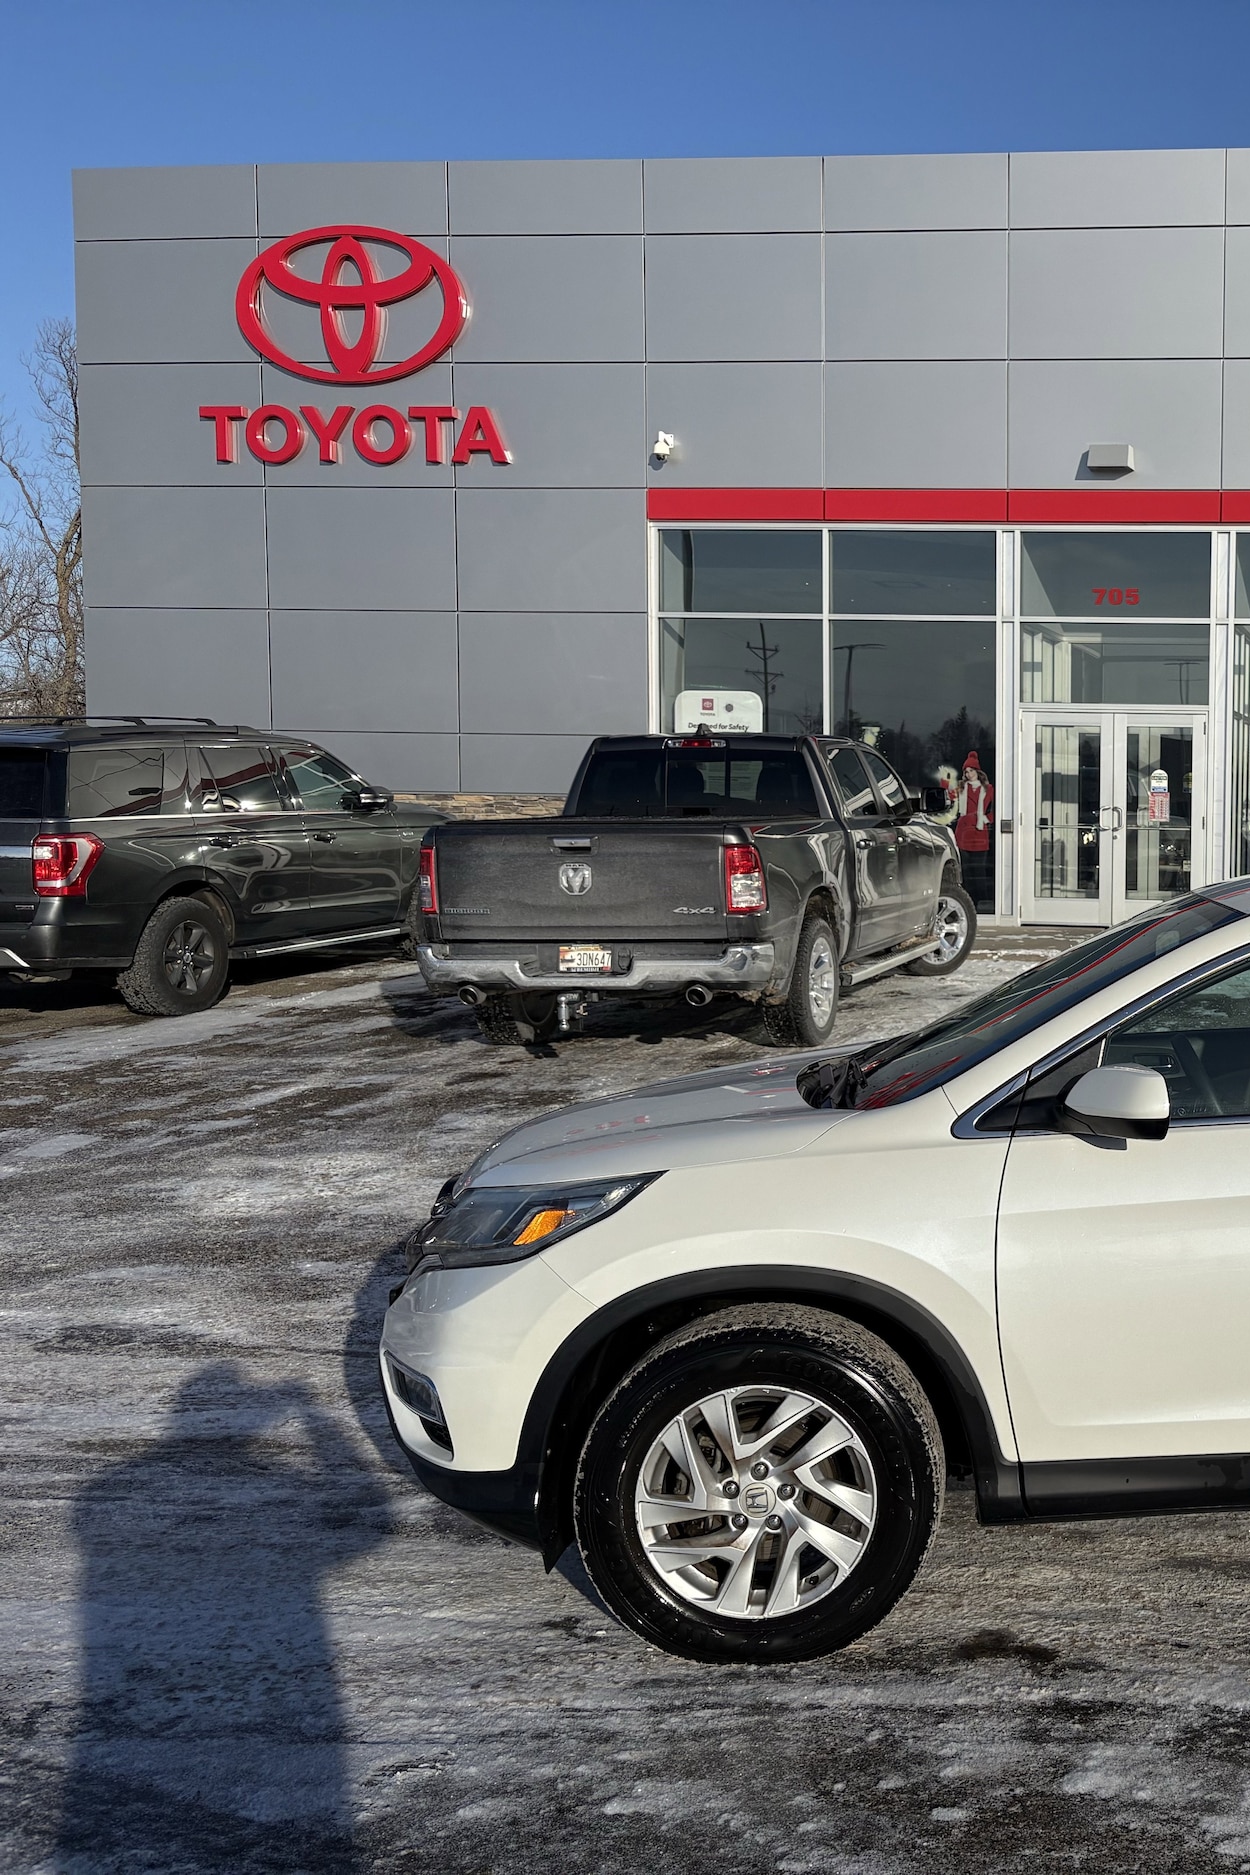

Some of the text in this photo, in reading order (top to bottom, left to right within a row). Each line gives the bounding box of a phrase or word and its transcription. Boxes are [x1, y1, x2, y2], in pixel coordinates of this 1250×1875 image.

[199, 404, 512, 464] TOYOTA
[1091, 587, 1140, 606] 705
[728, 723, 749, 733] Safety
[673, 906, 716, 914] 4x4
[576, 952, 612, 966] 3DN647
